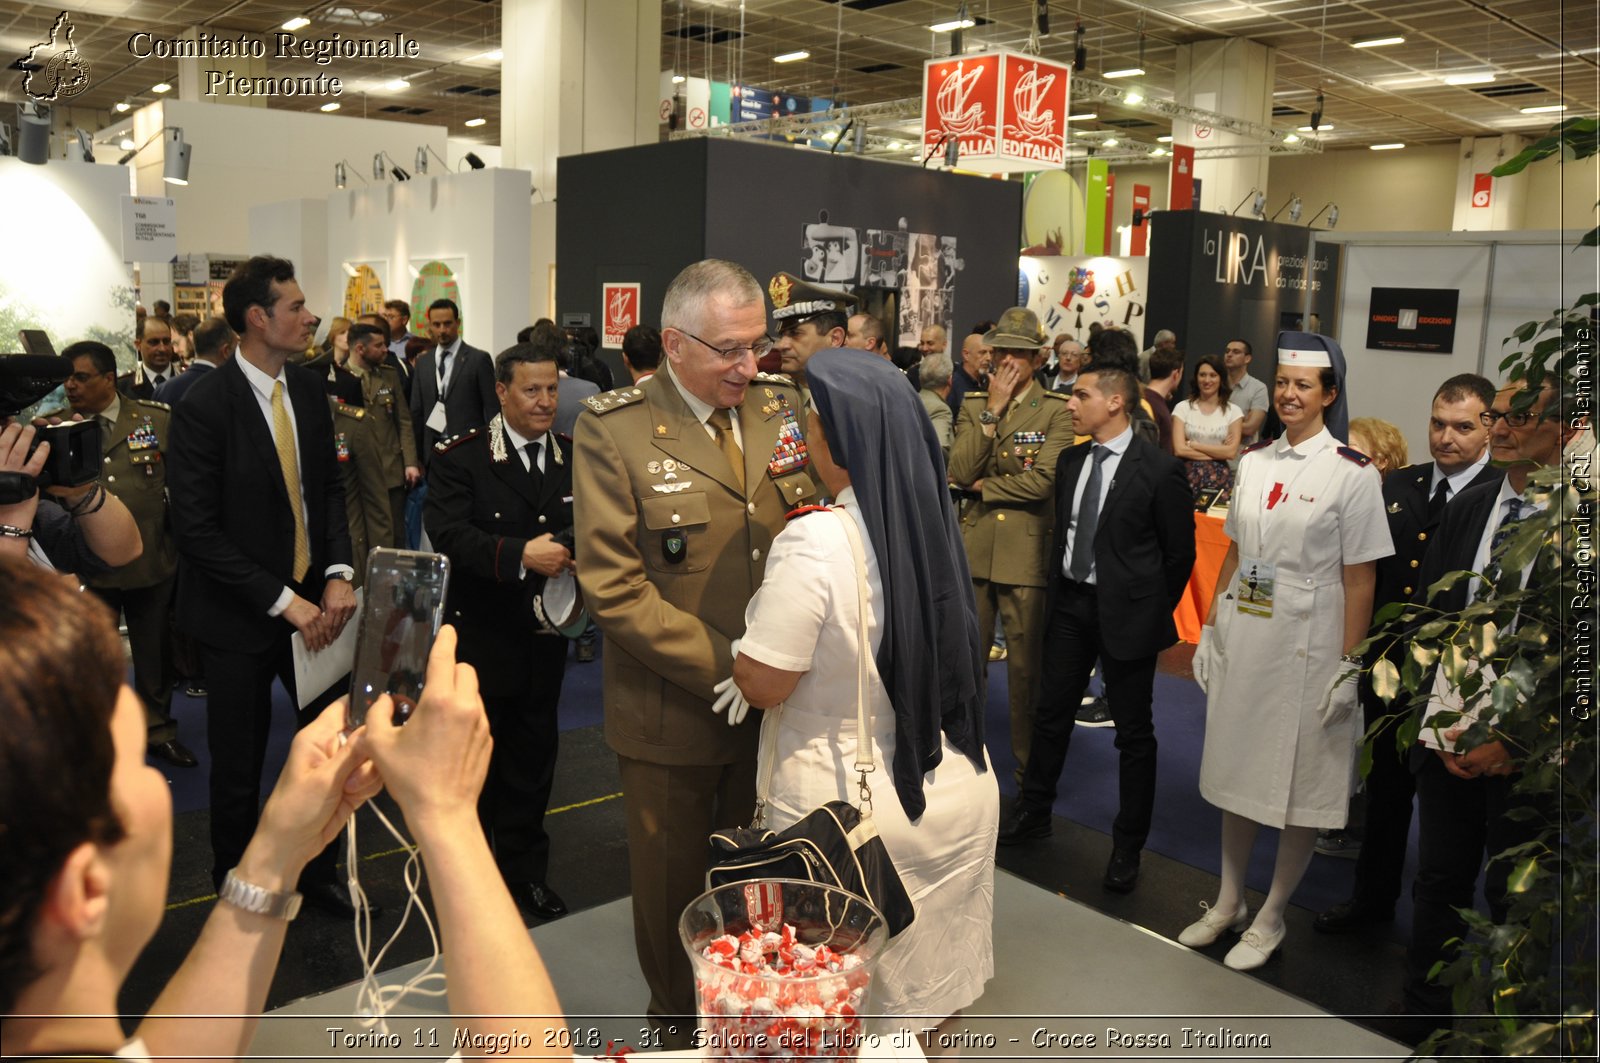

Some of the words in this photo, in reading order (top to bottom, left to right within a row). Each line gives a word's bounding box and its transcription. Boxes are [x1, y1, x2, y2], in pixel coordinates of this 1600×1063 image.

[924, 138, 994, 158] EDIALIA
[1002, 138, 1062, 163] EDITALIA
[1203, 229, 1216, 256] la
[1215, 230, 1269, 287] LIRA
[1121, 300, 1144, 326] P
[1373, 314, 1398, 323] UNDICI
[1418, 316, 1452, 325] EDIZIONI
[604, 334, 625, 344] EDITA
